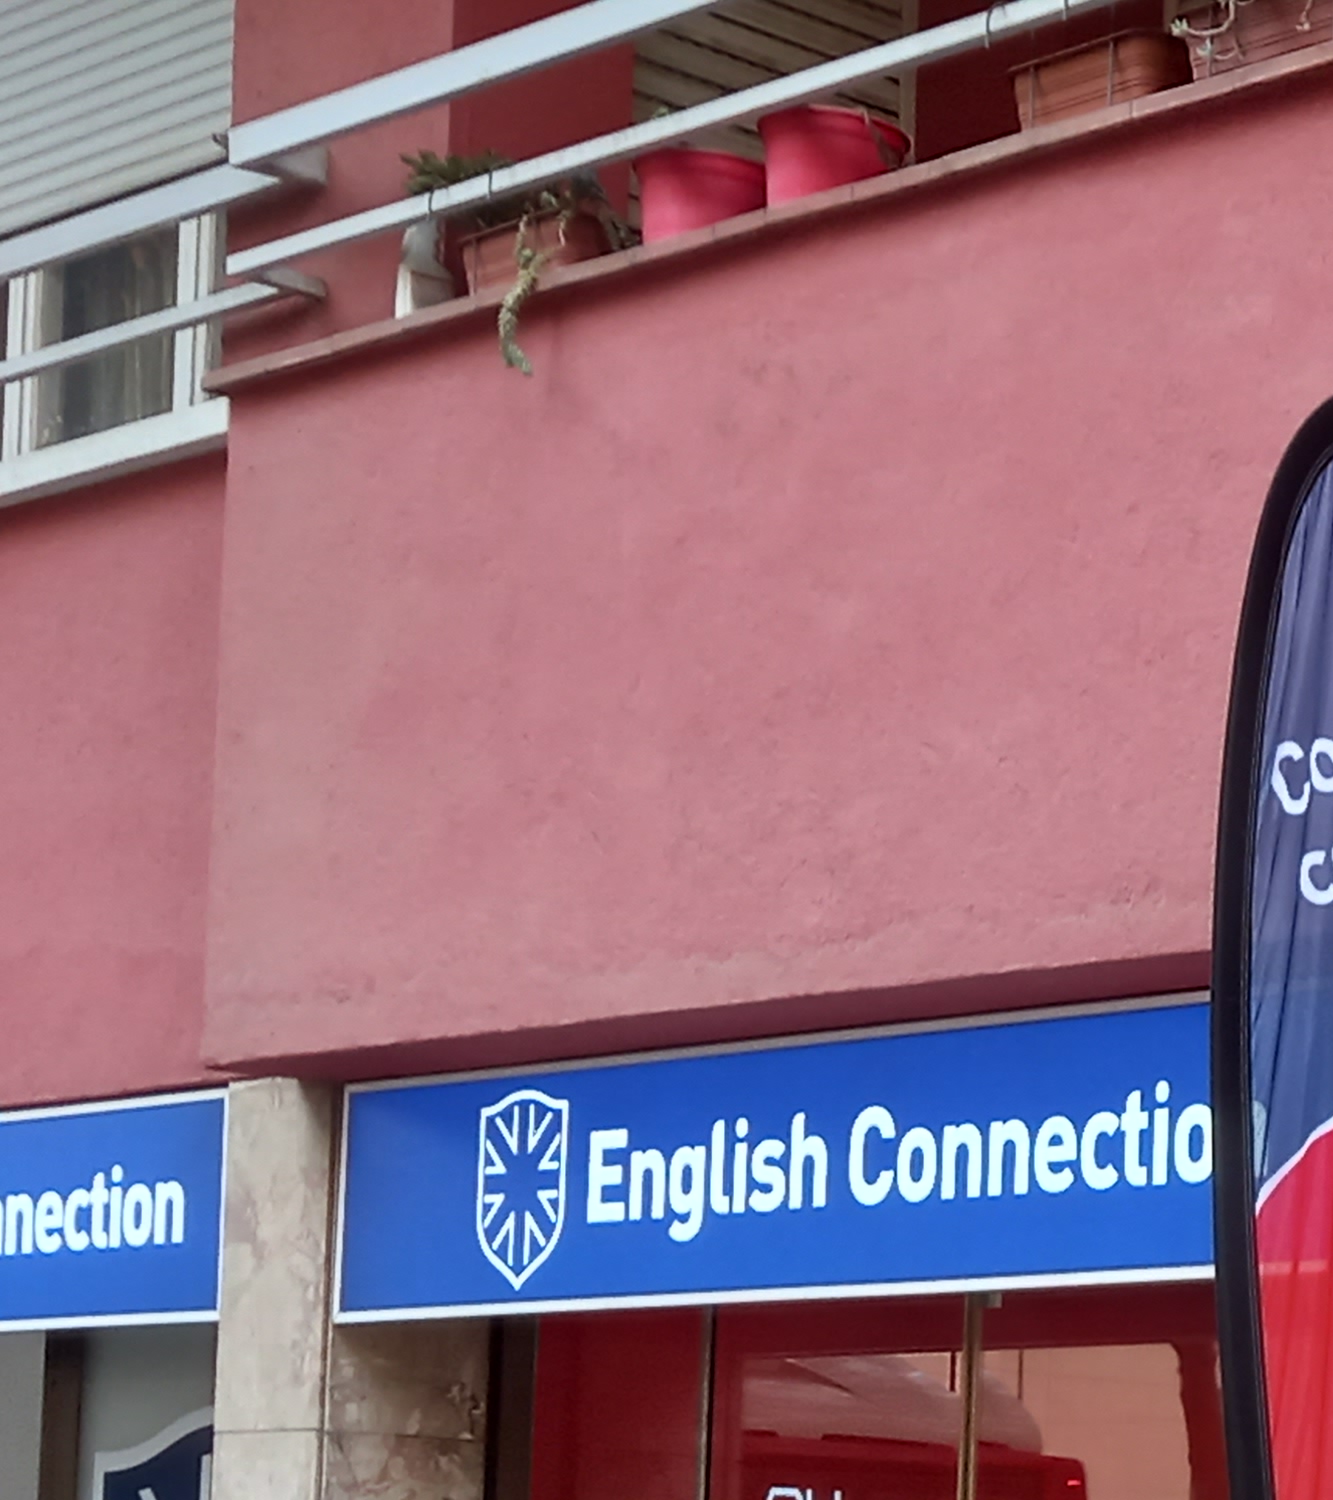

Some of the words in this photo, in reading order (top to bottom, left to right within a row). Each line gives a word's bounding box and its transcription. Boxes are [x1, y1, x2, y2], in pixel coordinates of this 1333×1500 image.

[0, 1164, 185, 1256] nection
[585, 1111, 828, 1243] English
[848, 1079, 1213, 1206] Connectio
